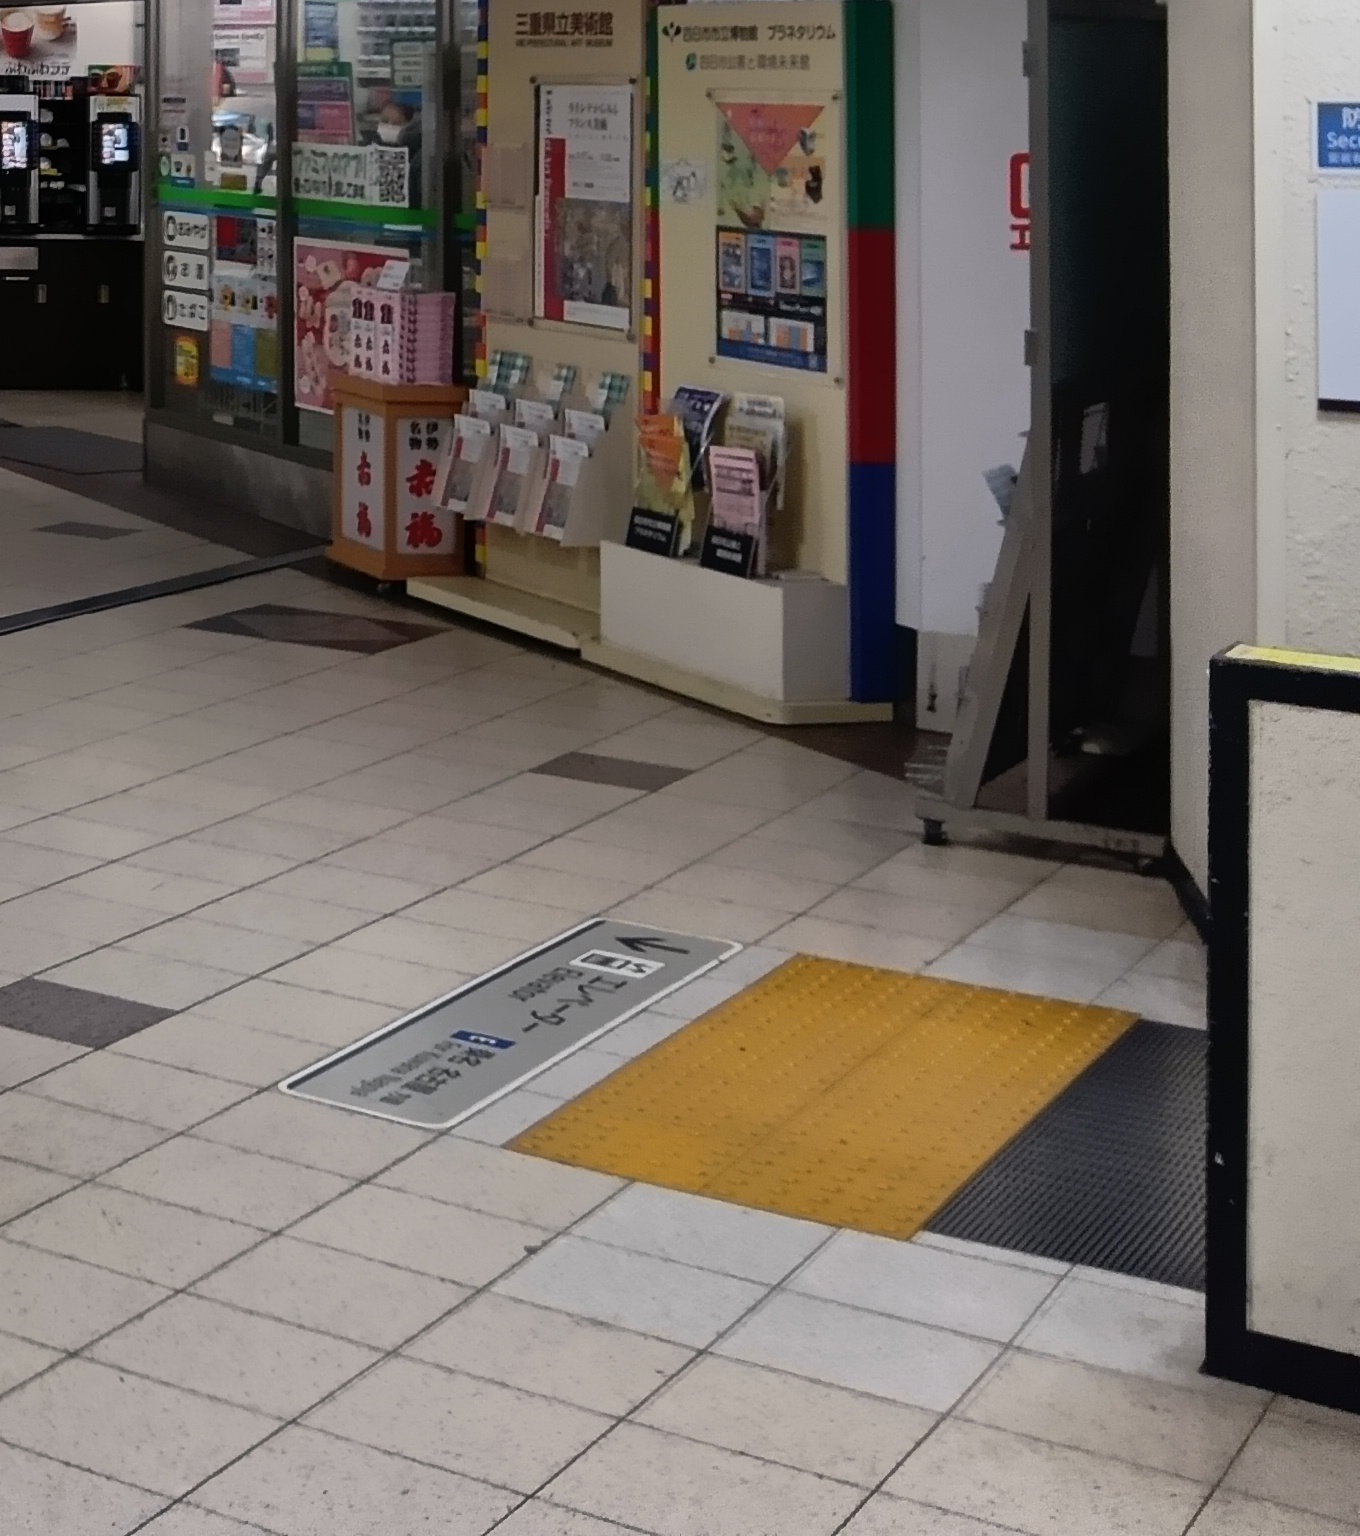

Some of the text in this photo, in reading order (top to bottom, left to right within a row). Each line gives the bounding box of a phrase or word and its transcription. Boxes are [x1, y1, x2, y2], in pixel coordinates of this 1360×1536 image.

[515, 11, 614, 36] 三重県立美術館
[767, 24, 836, 42] プラネタリウム
[1326, 131, 1360, 150] Sec
[521, 975, 629, 1034] エレベーター
